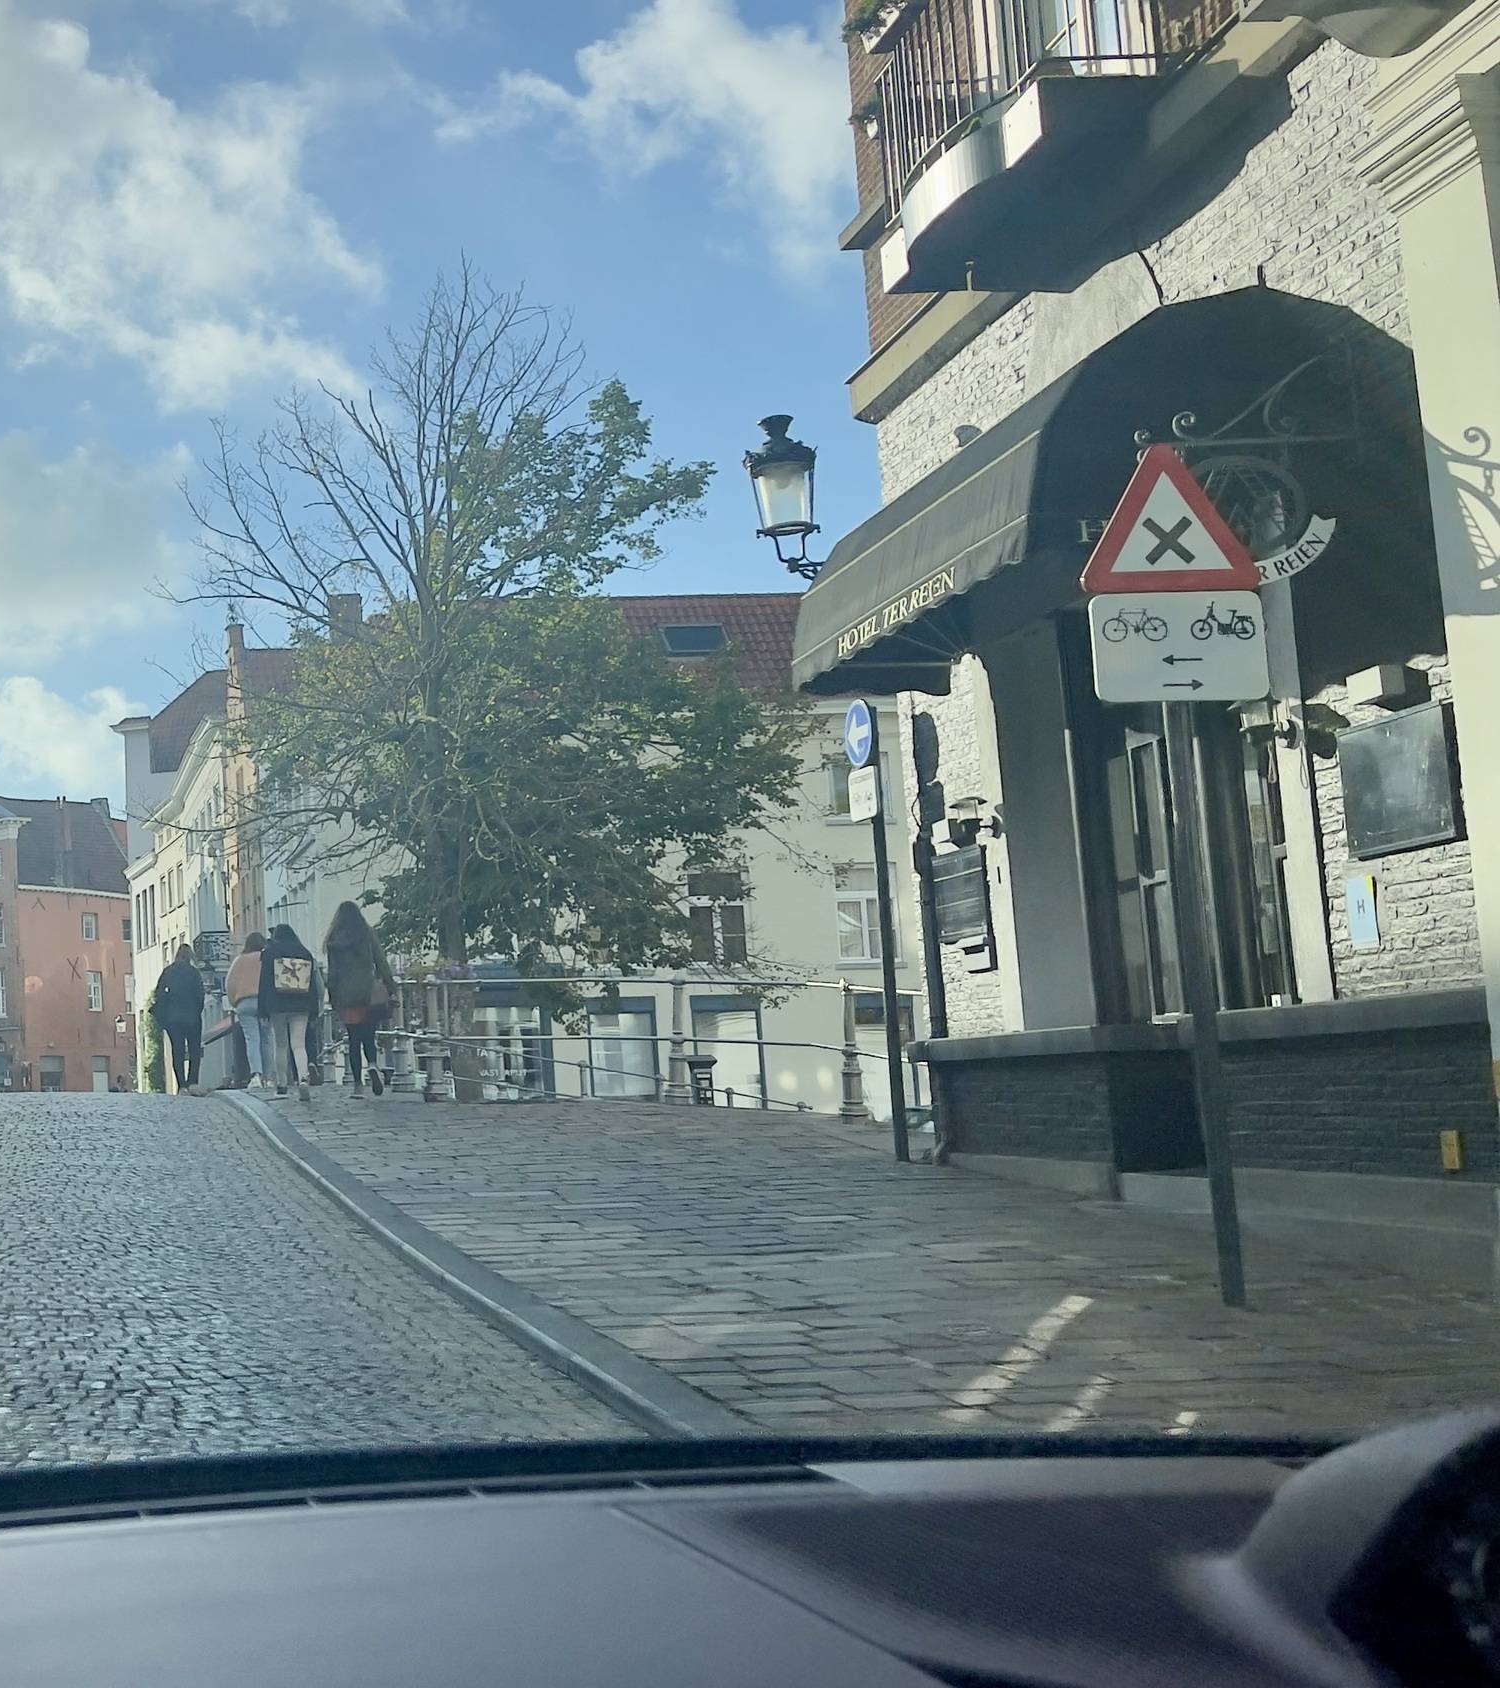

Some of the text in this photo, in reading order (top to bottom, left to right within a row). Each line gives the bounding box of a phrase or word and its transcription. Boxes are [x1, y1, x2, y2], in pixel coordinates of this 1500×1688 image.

[1273, 532, 1326, 576] REIEN
[837, 566, 955, 657] HOTEL TER REIEN
